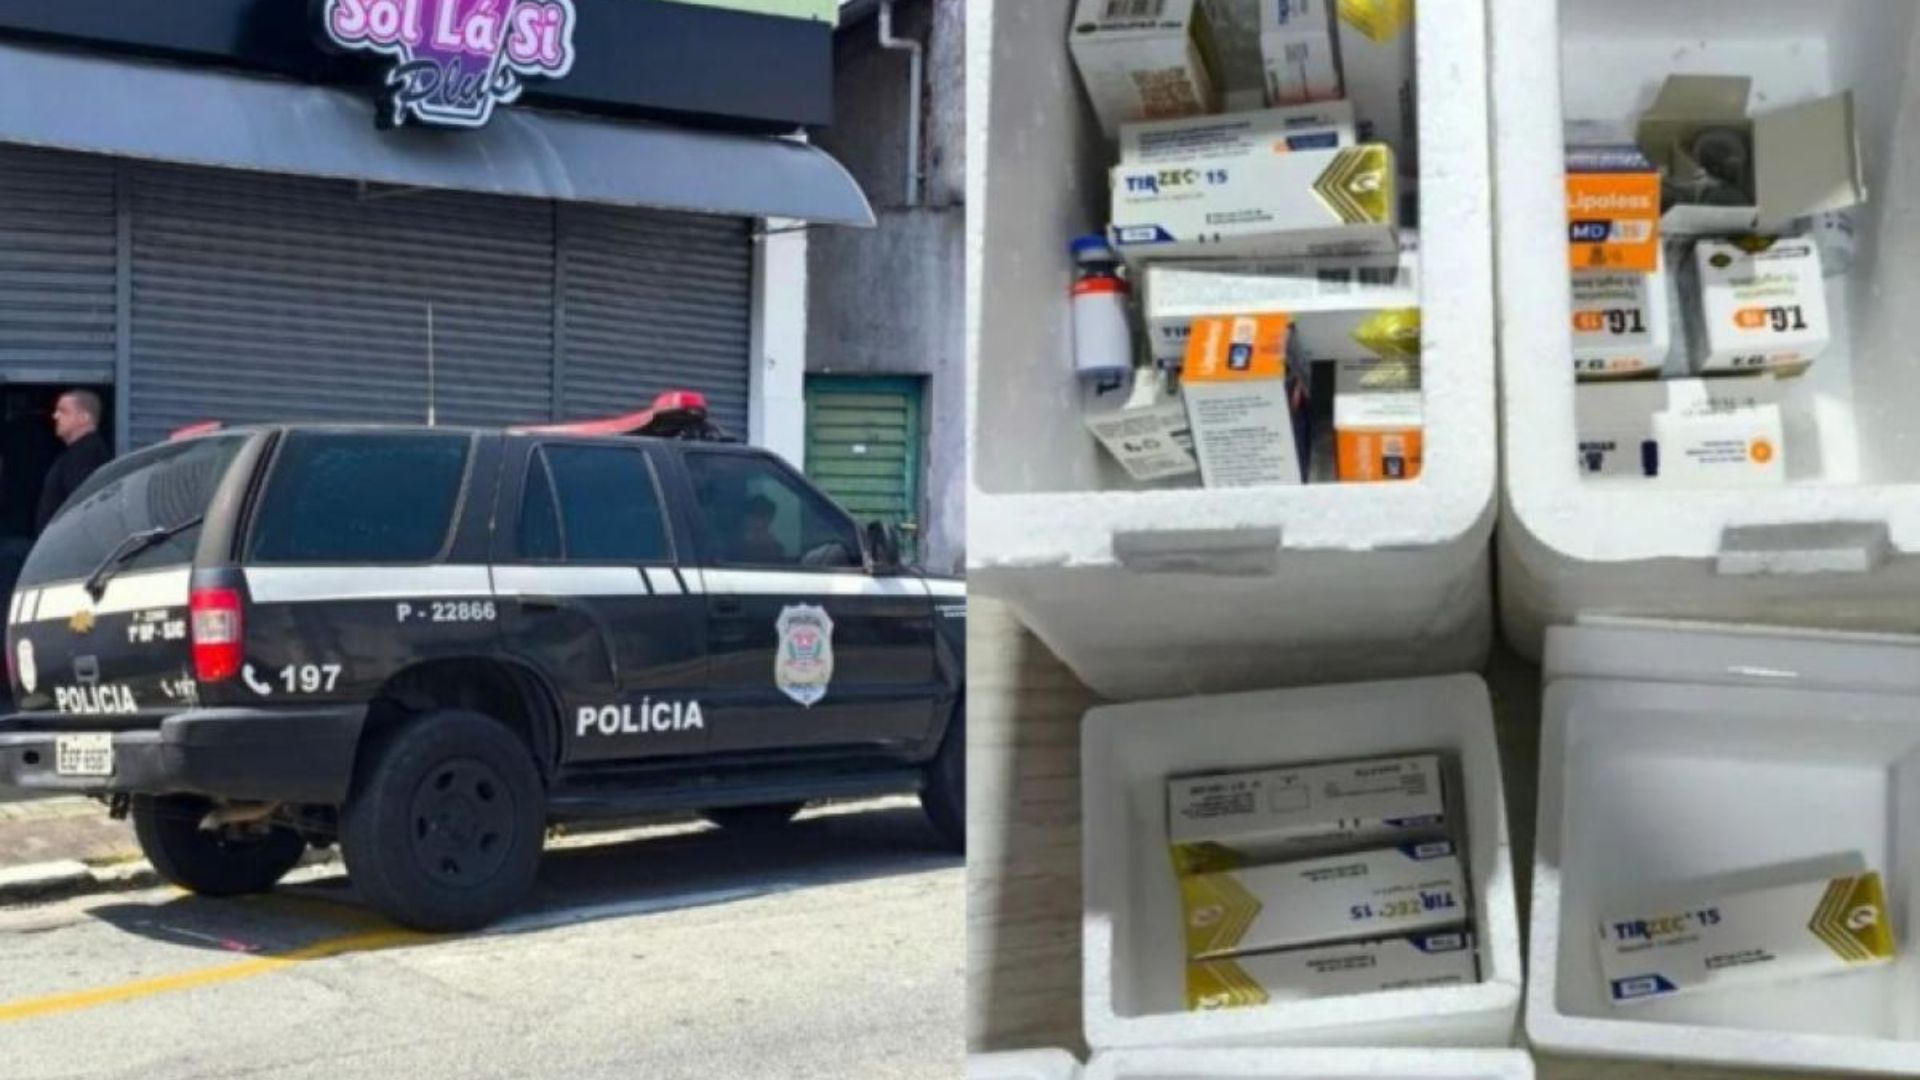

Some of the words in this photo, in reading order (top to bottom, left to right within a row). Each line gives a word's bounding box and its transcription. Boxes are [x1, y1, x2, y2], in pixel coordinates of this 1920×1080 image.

[336, 0, 420, 42] Sol
[436, 0, 494, 50] Lá
[512, 7, 558, 60] Si
[386, 56, 521, 125] Plus
[1125, 169, 1195, 194] TIRZEC
[1206, 169, 1229, 184] 15
[397, 604, 412, 622] P
[432, 602, 496, 622] 22866
[279, 664, 342, 692] 197
[576, 697, 703, 736] POLÍCIA
[1614, 914, 1685, 939] TIRZEC
[1697, 907, 1721, 926] 15
